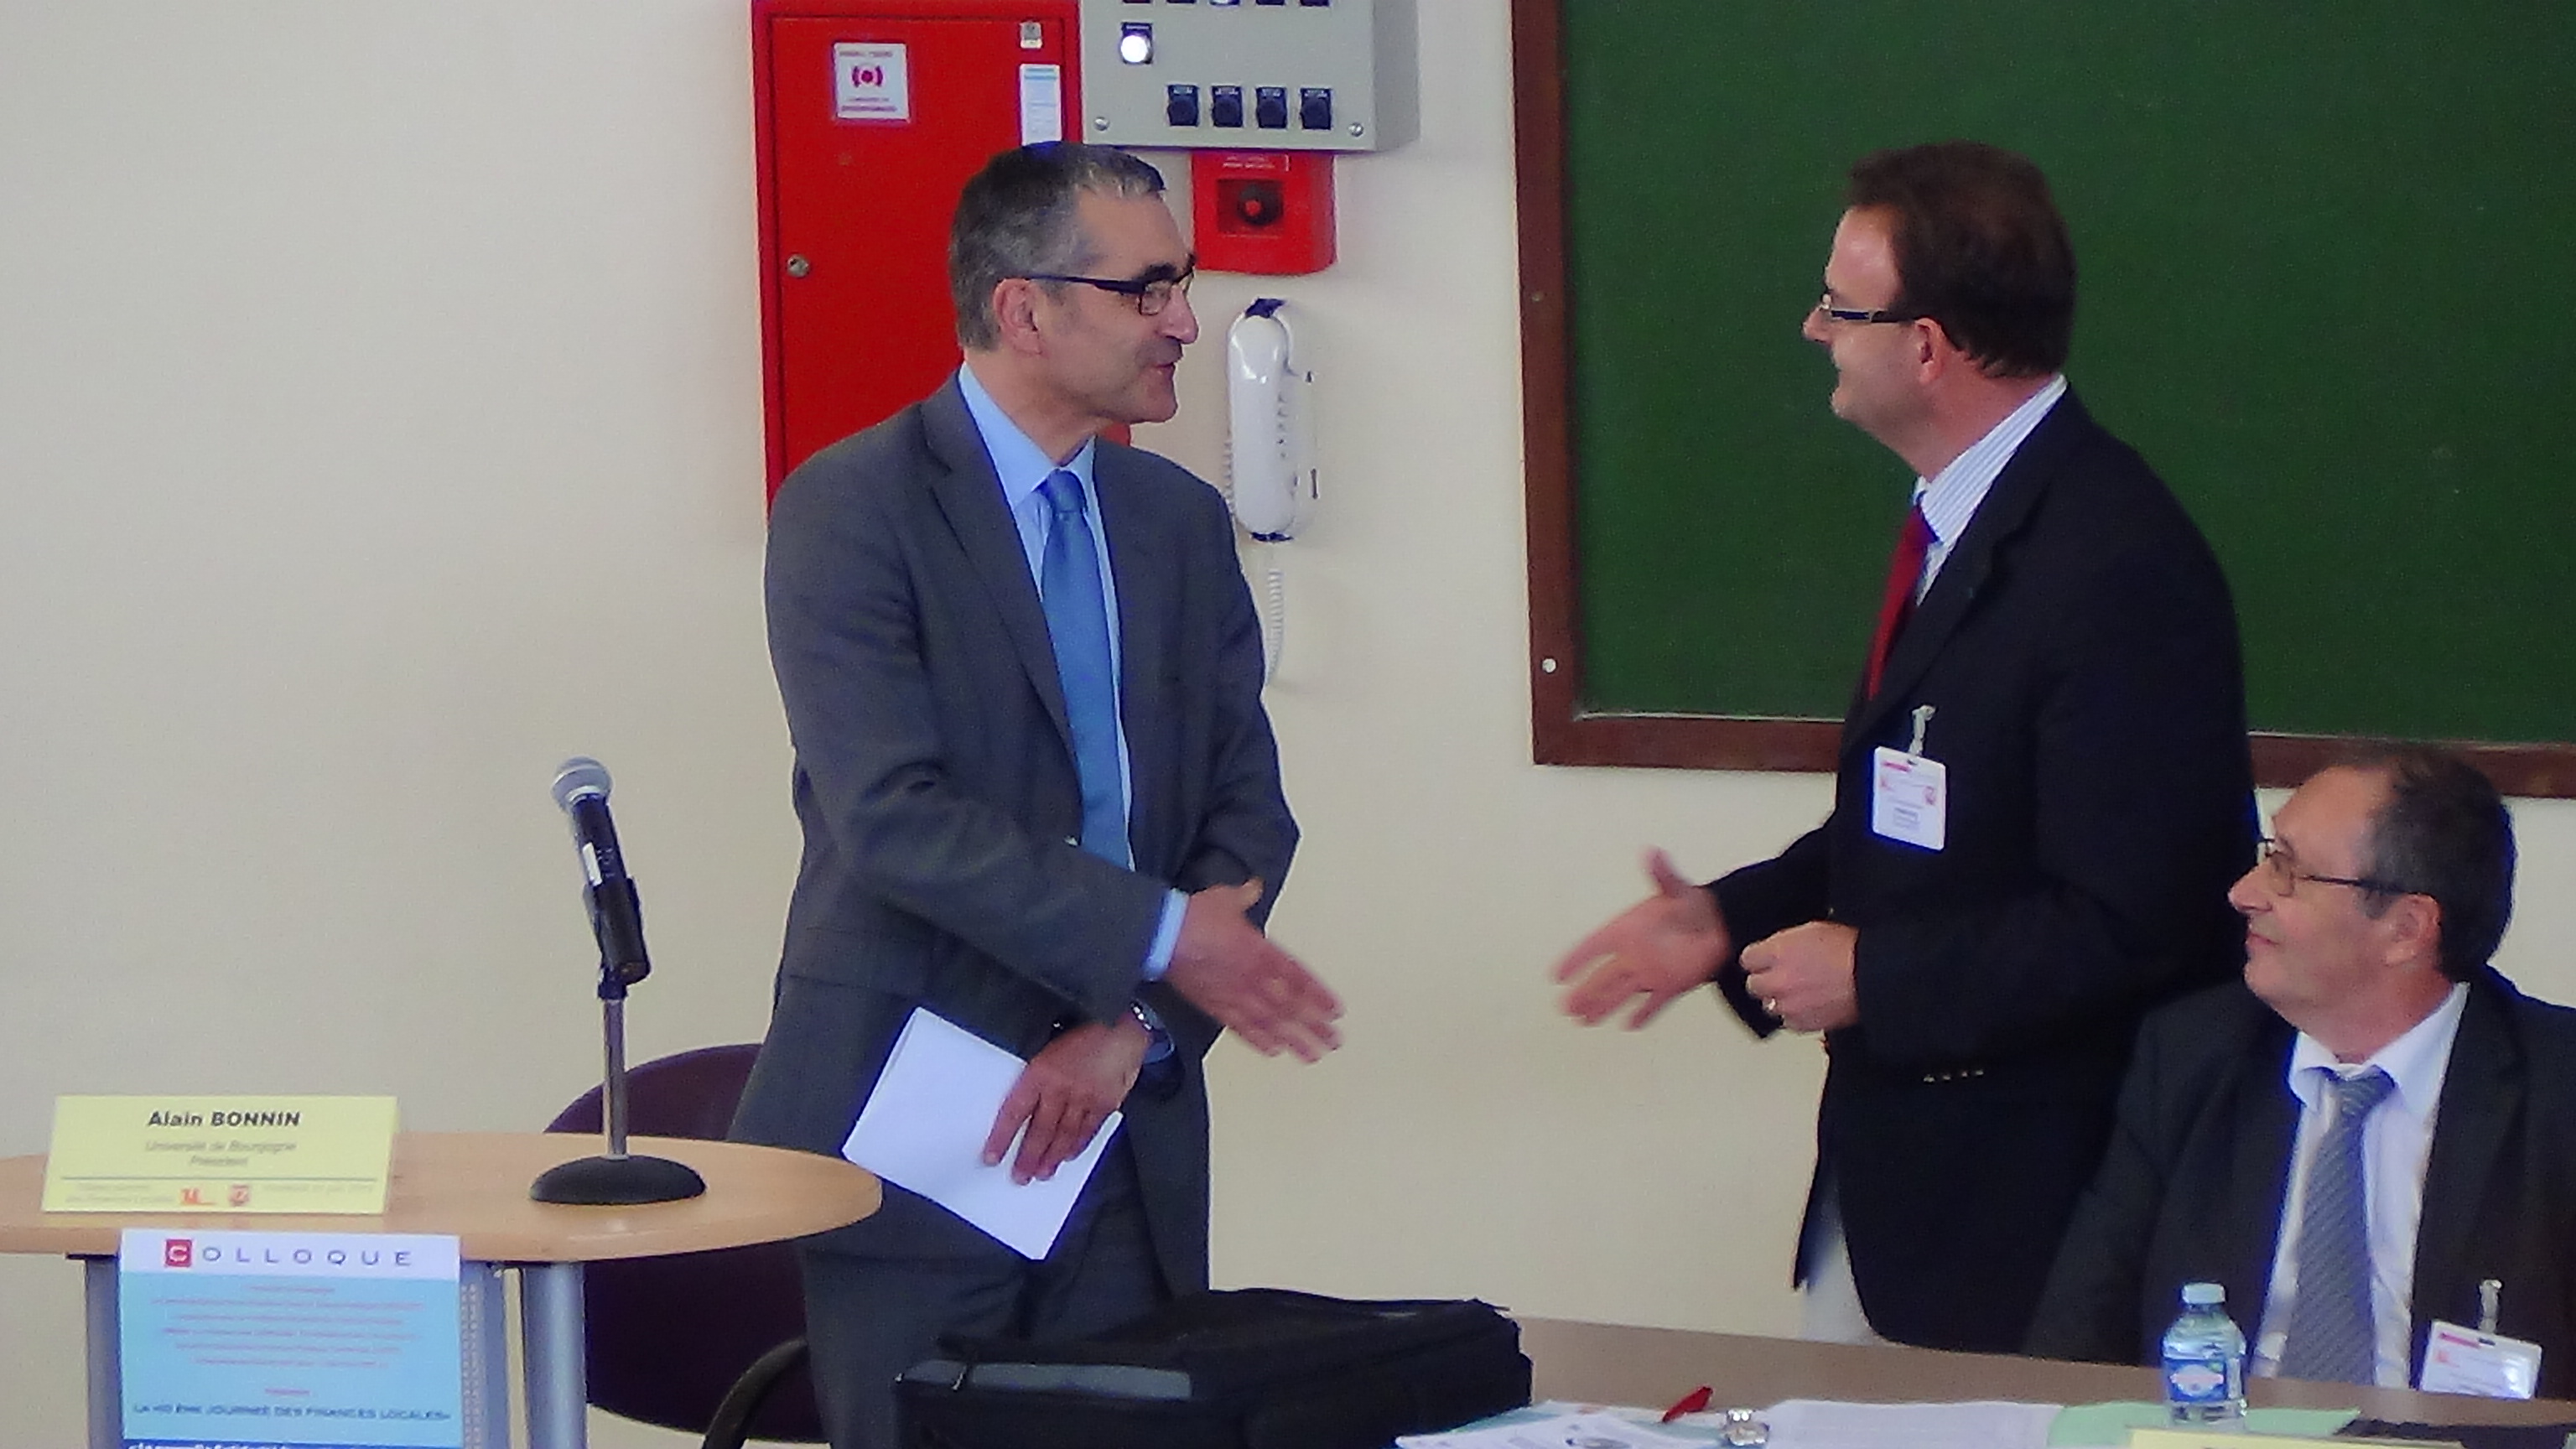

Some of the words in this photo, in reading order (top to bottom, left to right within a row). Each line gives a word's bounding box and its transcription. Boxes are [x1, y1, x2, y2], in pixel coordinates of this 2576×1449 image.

[148, 1110, 203, 1127] Alain
[210, 1110, 300, 1128] BONNIN
[168, 1244, 412, 1267] COLLOQUE
